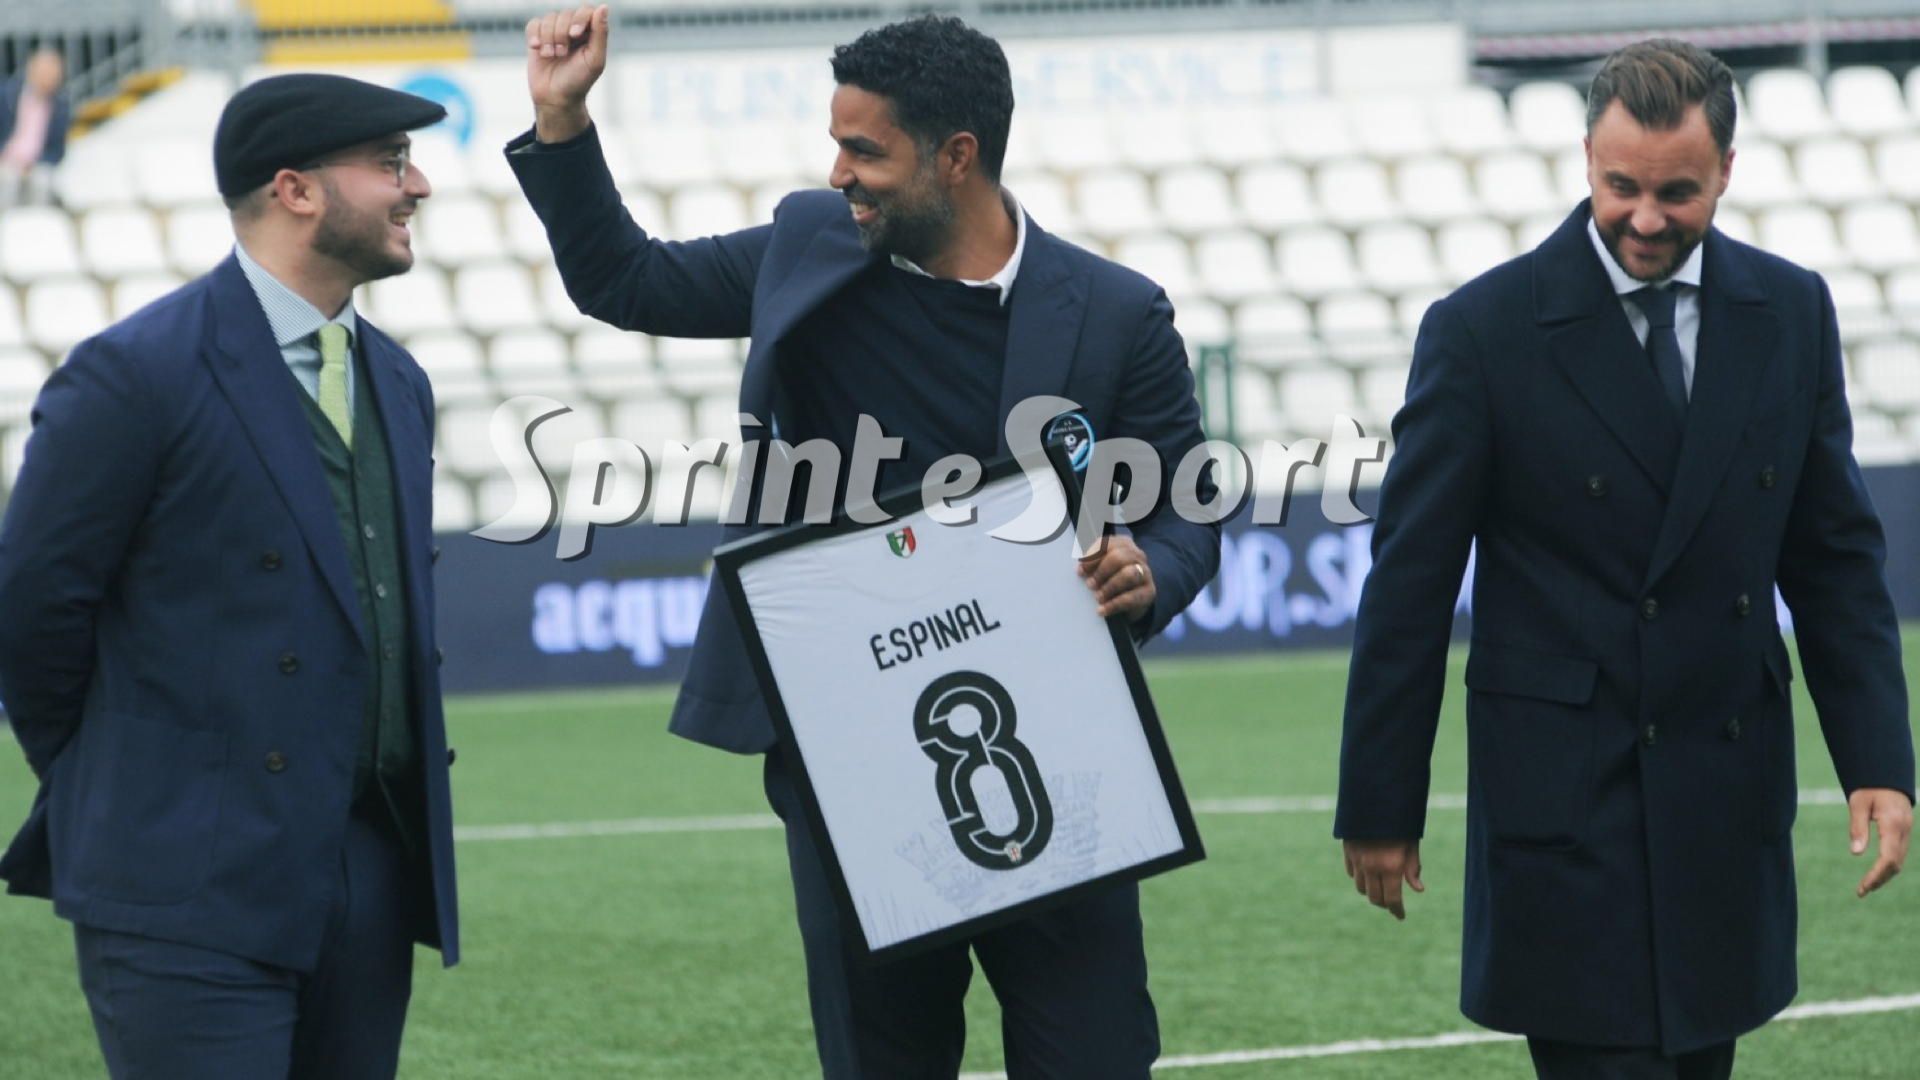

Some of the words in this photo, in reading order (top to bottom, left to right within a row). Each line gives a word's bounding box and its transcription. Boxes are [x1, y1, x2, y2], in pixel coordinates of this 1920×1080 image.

[532, 575, 711, 668] acqu
[870, 598, 1001, 671] ESPINAL
[913, 670, 1053, 871] 8
